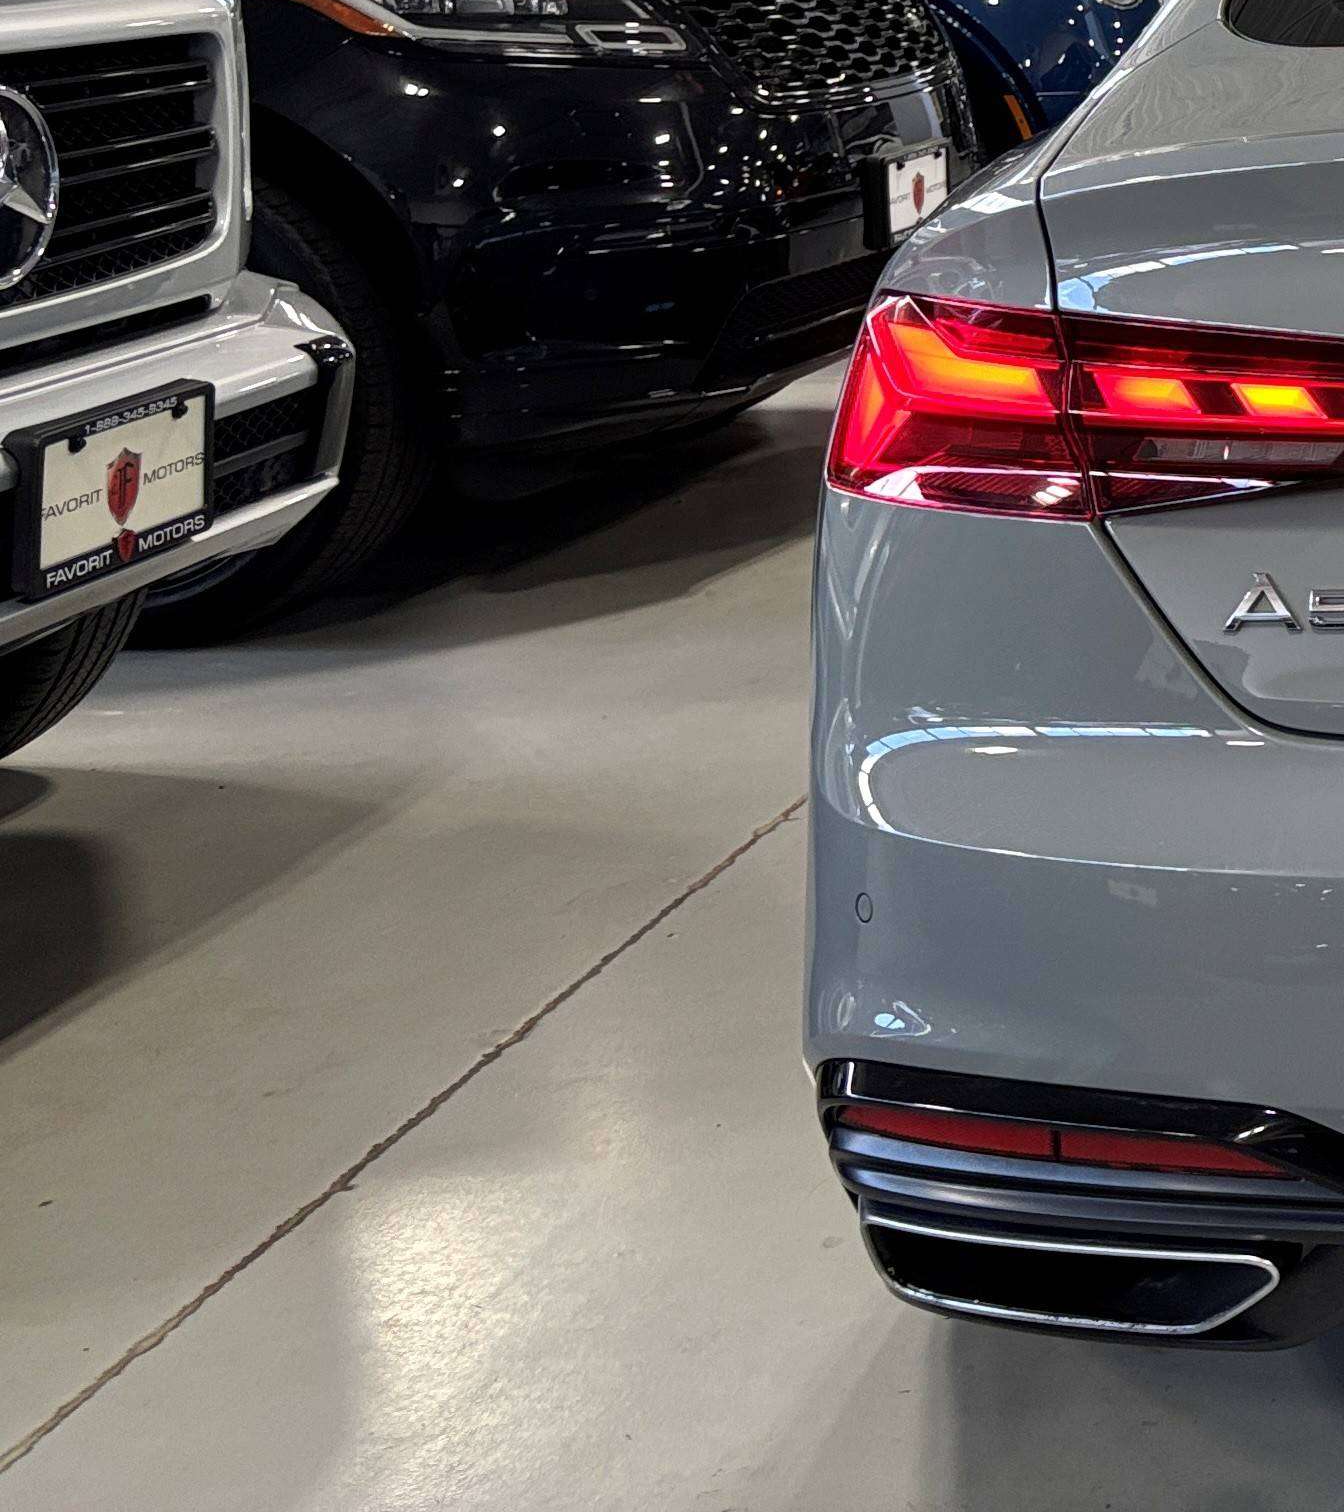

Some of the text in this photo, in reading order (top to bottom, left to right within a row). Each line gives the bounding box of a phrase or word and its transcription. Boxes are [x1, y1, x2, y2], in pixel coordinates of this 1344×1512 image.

[143, 451, 206, 486] MOTORS
[46, 514, 205, 589] FAVORIT MOTORS
